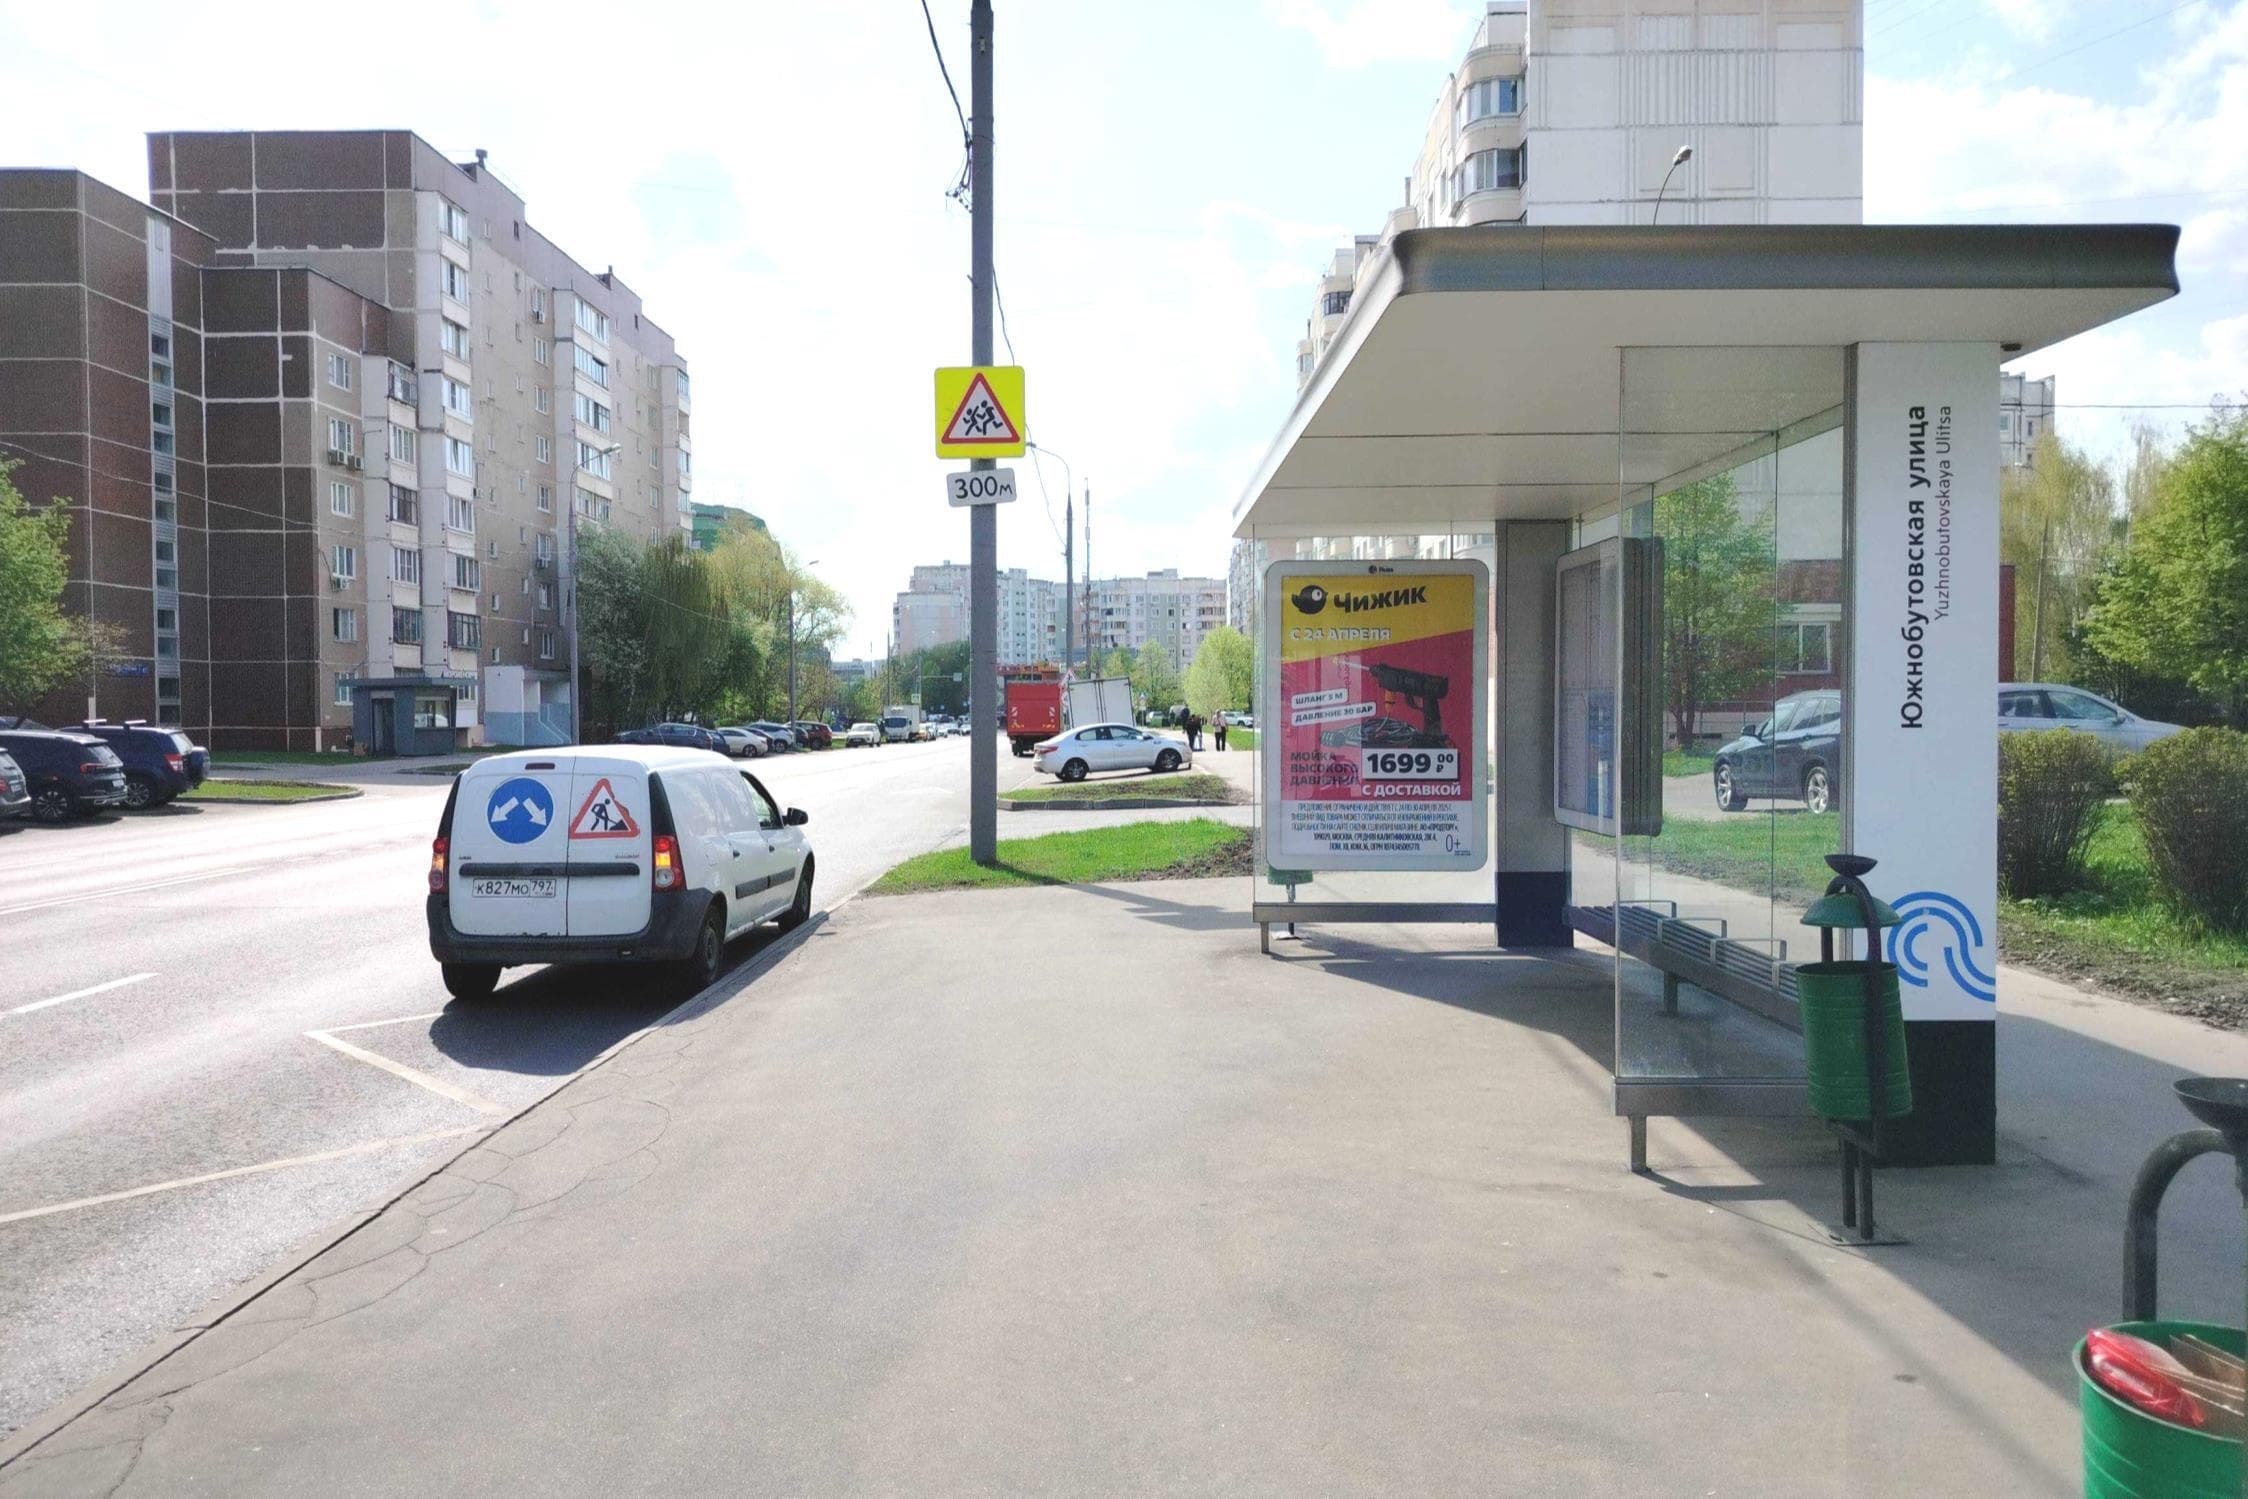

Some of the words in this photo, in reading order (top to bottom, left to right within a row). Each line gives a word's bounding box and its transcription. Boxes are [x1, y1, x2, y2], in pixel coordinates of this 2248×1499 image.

[1935, 405, 1951, 454] Ulitsa
[1908, 406, 1931, 489] улица
[1934, 459, 1954, 621] Yuzhnobutovskaya
[1900, 501, 1929, 729] Южнобутовская
[1290, 629, 1301, 641] С
[1303, 629, 1324, 641] 24
[1327, 628, 1393, 641] АПРЕЛЯ
[1295, 696, 1326, 705] ШЛАНГ
[1295, 711, 1341, 723] ДАВЛЕНИЕ
[1290, 751, 1336, 761] МОЙКА
[1367, 753, 1431, 774] 1699
[1437, 753, 1454, 763] 00
[1290, 763, 1358, 773] ВЫСОКОГО
[1362, 785, 1371, 795] С
[1374, 782, 1461, 797] ДОСТАВКОЙ
[1446, 834, 1461, 852] 0+
[531, 880, 552, 891] 797
